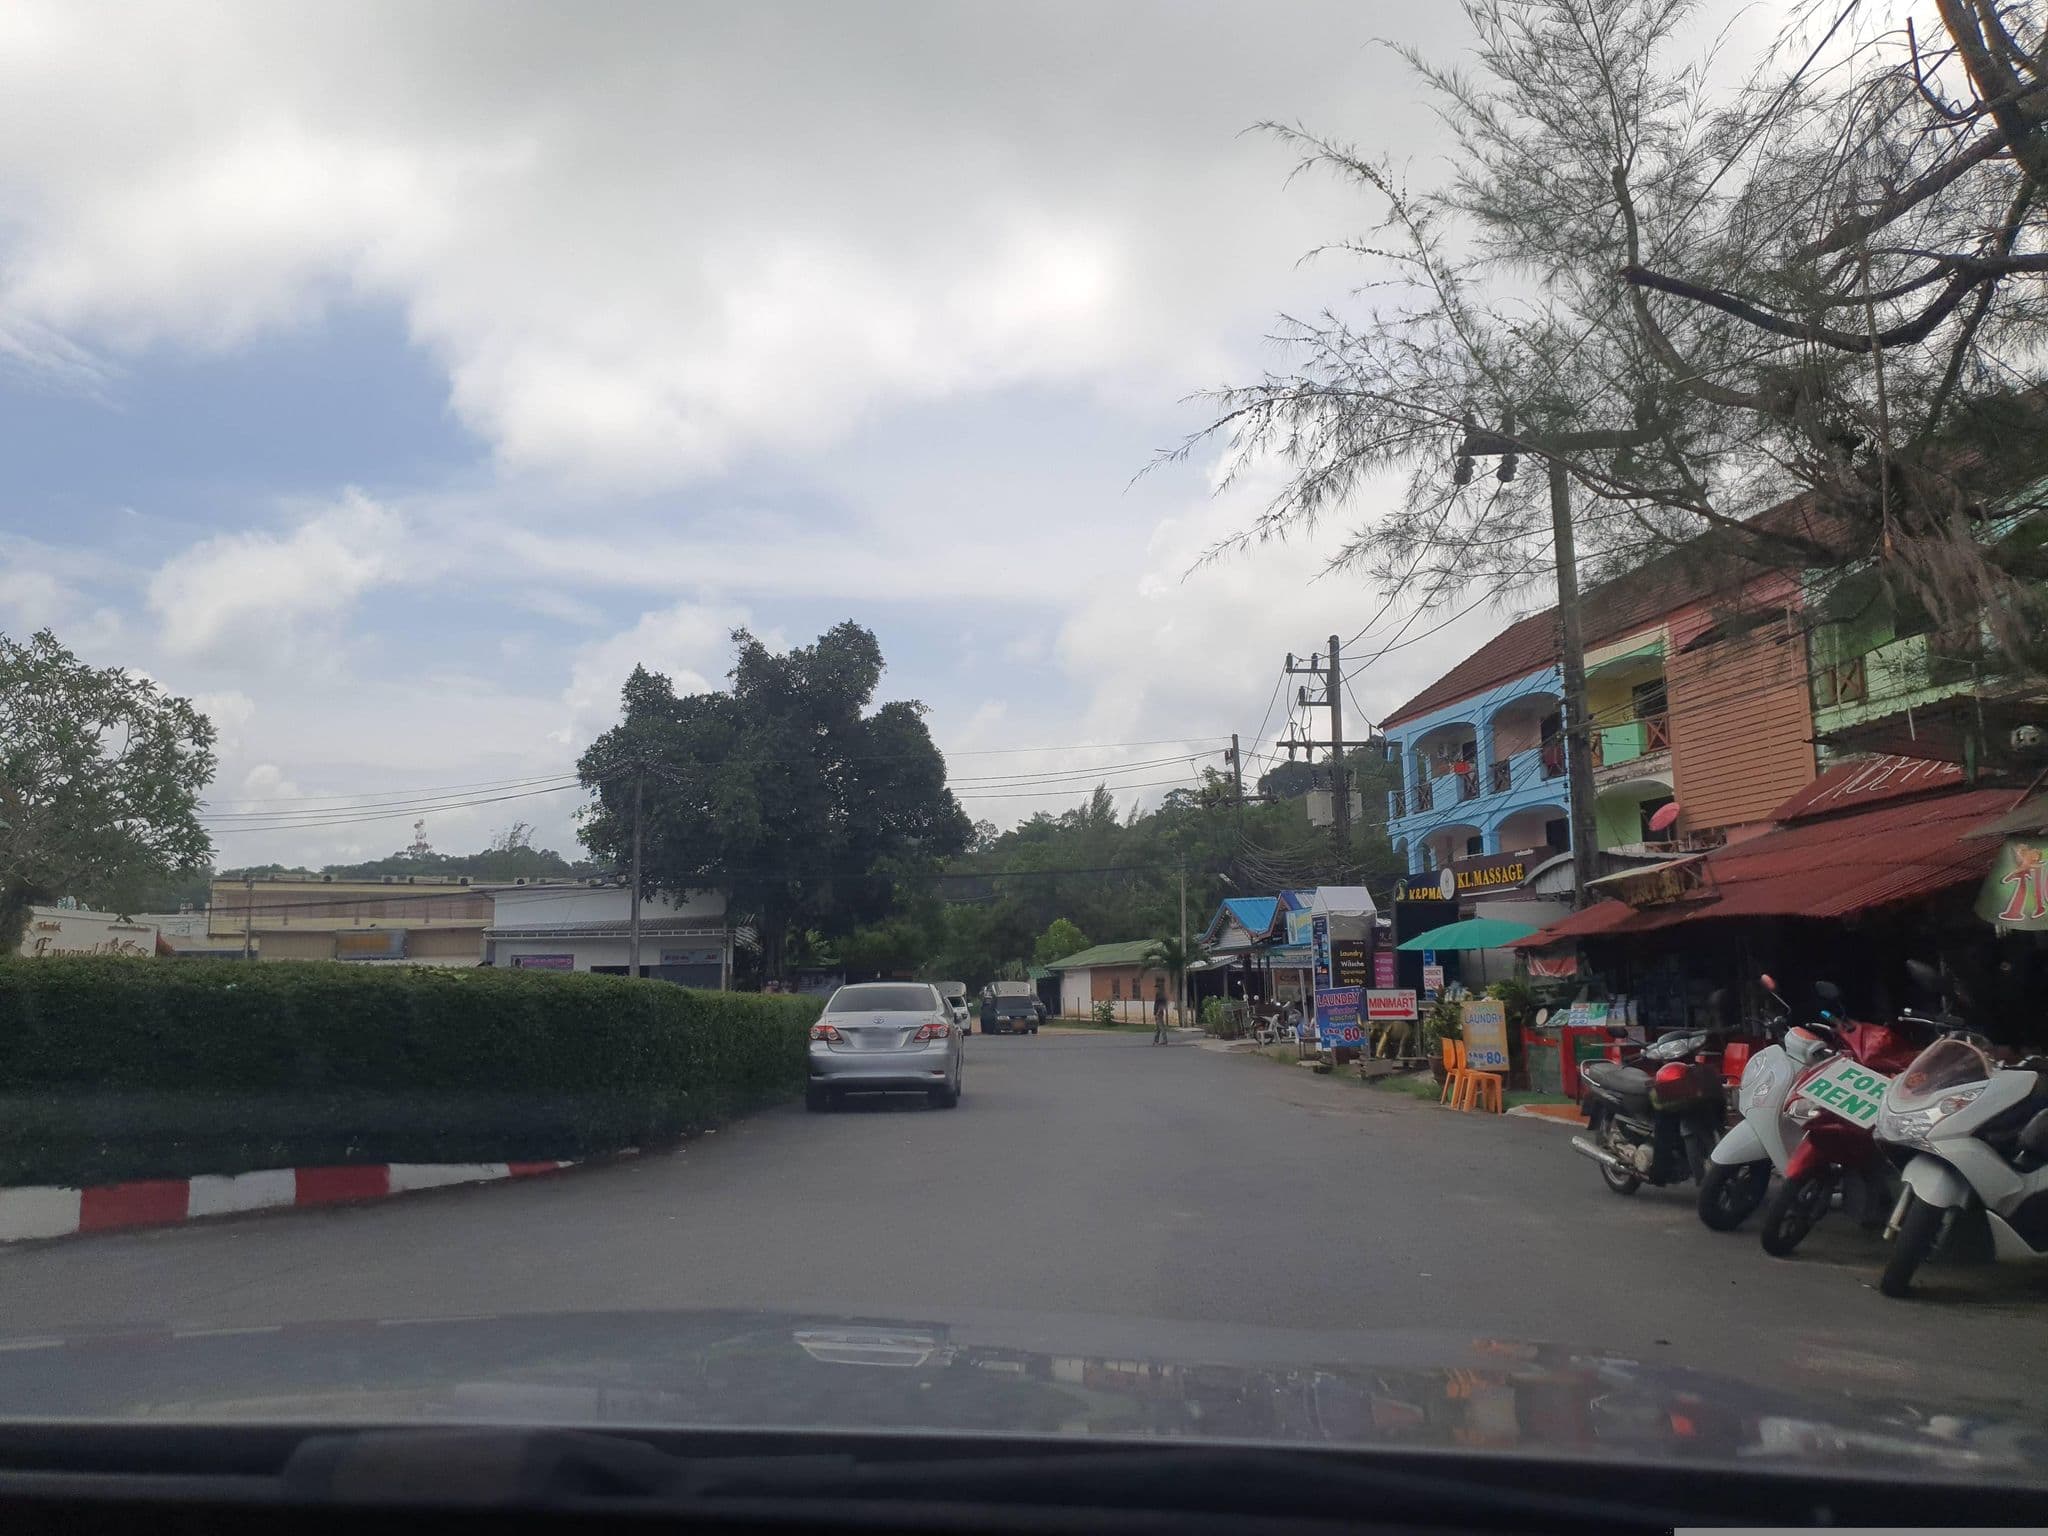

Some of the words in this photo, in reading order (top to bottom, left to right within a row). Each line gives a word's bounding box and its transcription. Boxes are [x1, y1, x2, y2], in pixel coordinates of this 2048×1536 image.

[1457, 864, 1524, 888] KL.MASSAGE
[1317, 991, 1360, 1008] LAUNDRY
[1369, 997, 1415, 1009] MINIMART
